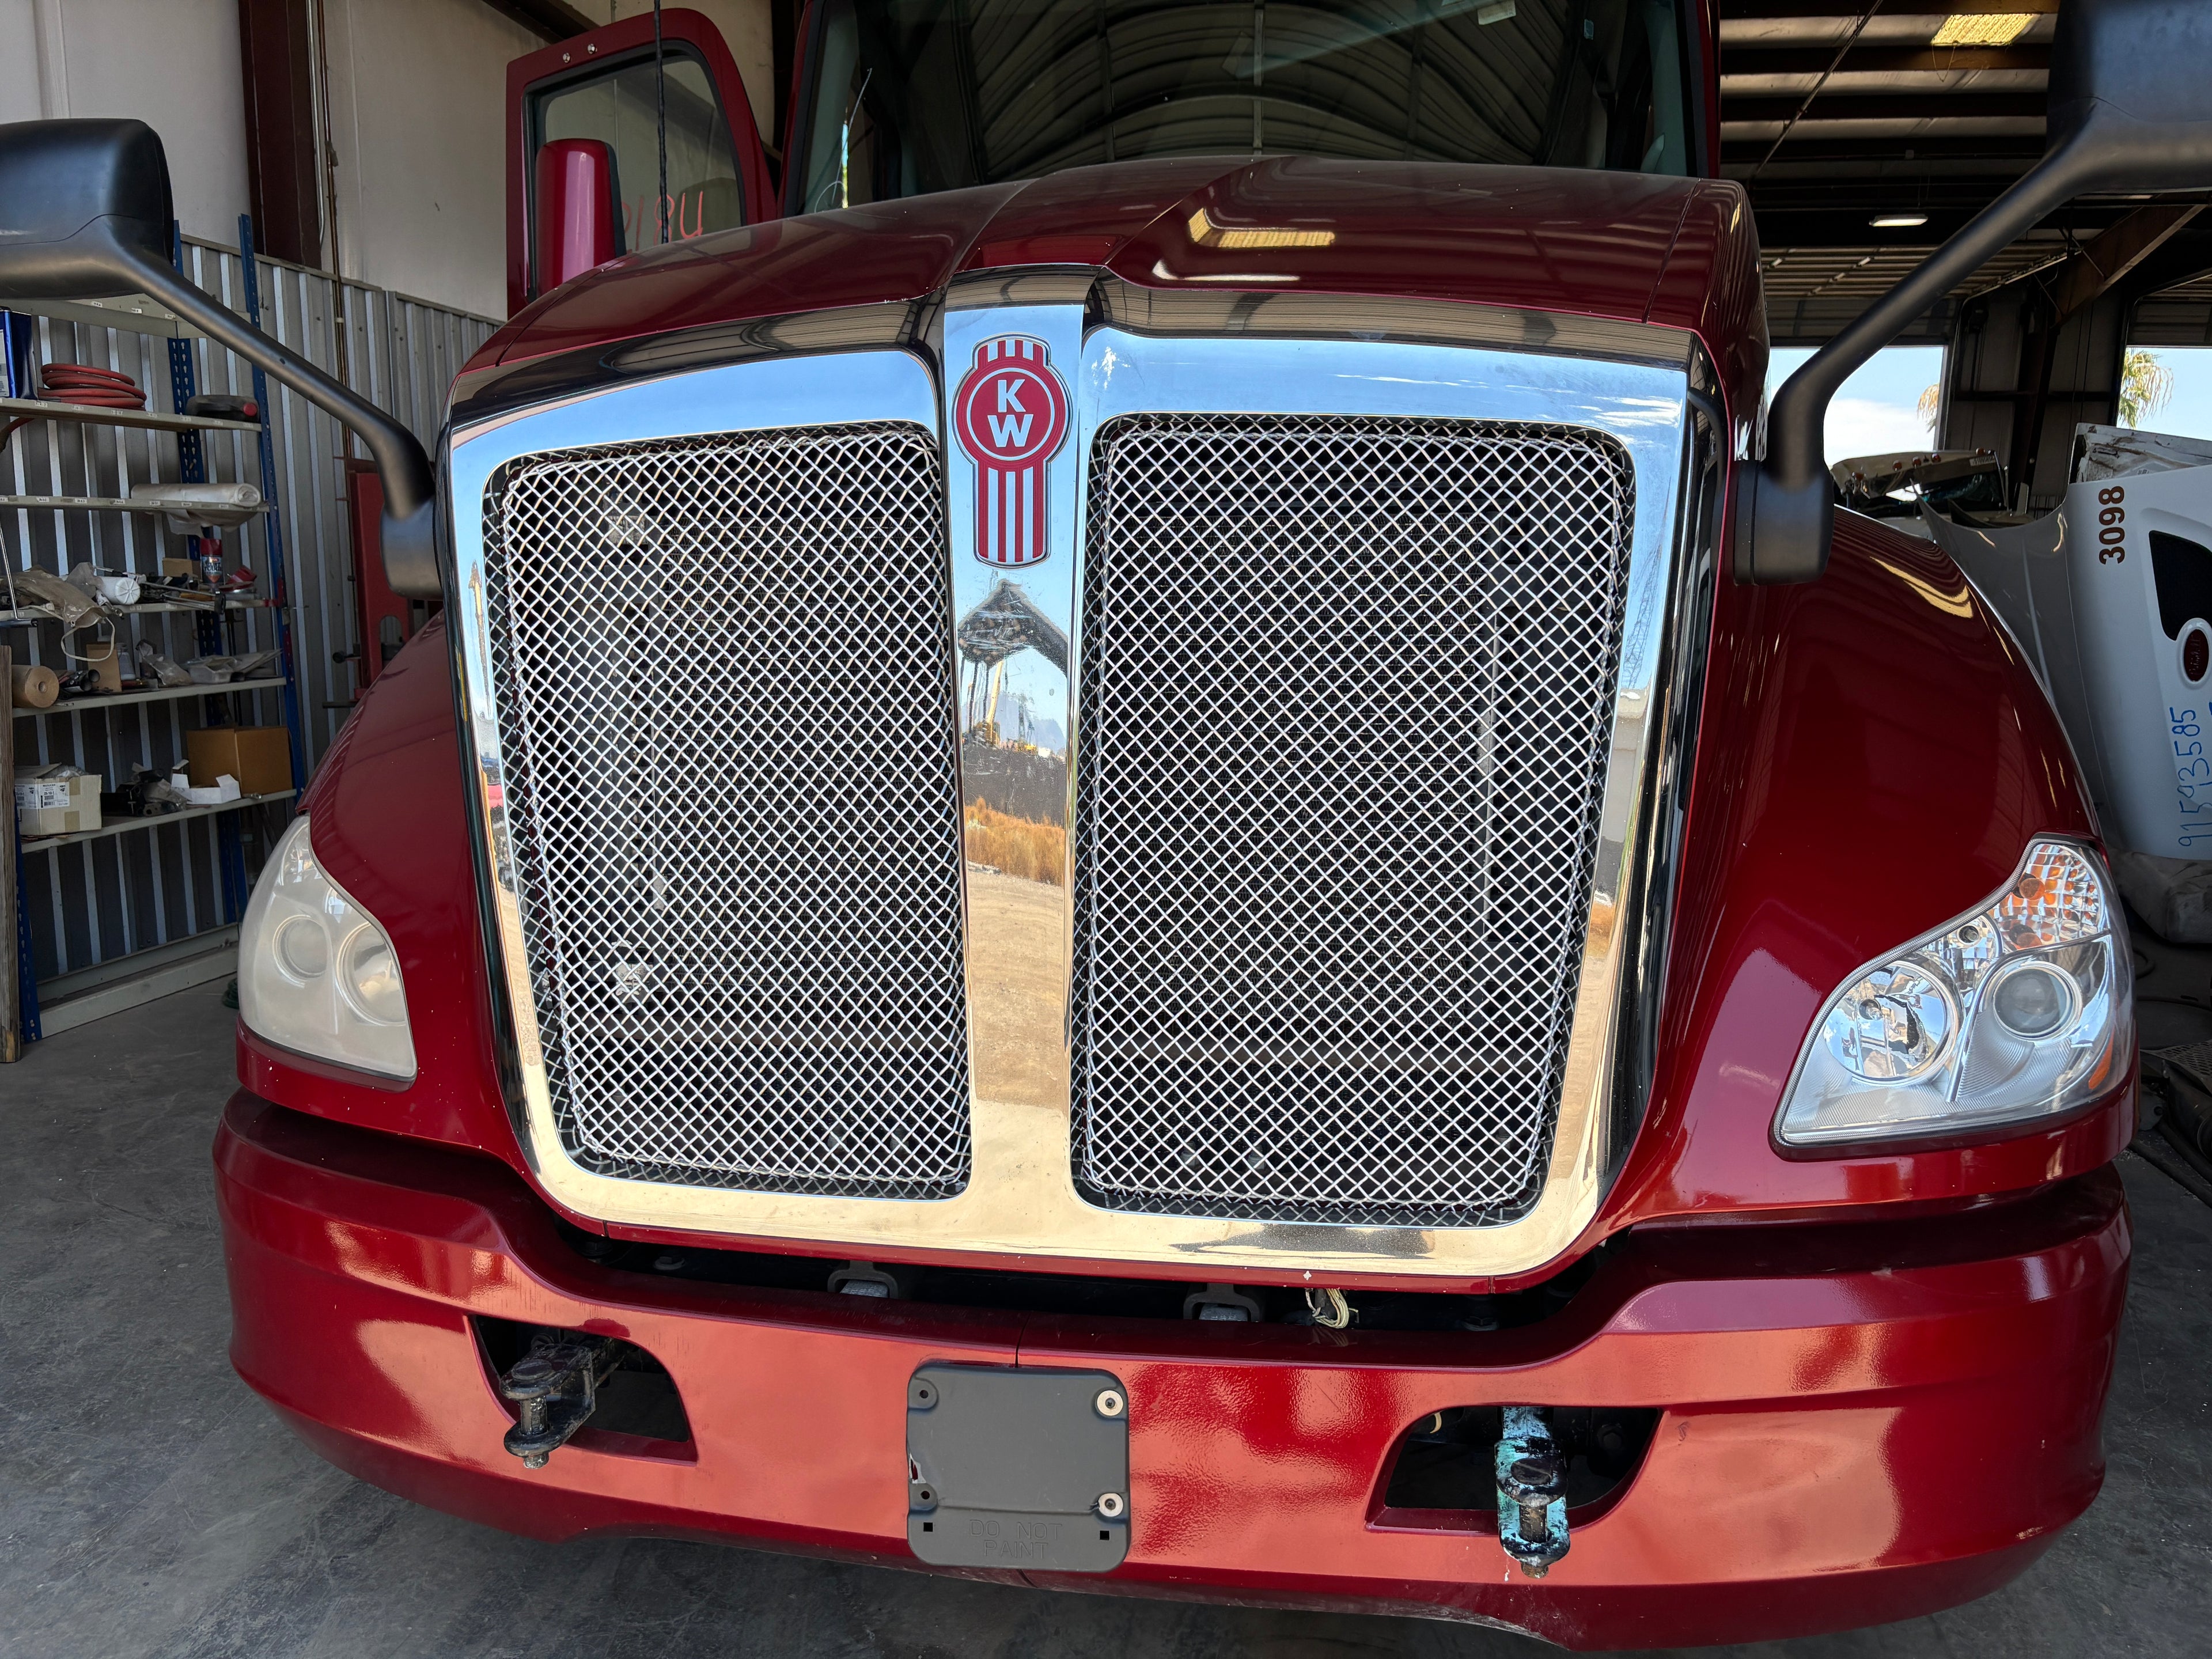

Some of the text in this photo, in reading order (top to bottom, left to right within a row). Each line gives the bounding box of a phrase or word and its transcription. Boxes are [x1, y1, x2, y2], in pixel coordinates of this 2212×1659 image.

[998, 379, 1027, 413] K
[987, 414, 1034, 448] W
[2098, 486, 2126, 565] 3098
[2169, 706, 2212, 847] 91593585
[969, 1519, 1062, 1540] DO NOT
[983, 1539, 1048, 1559] PAINT
